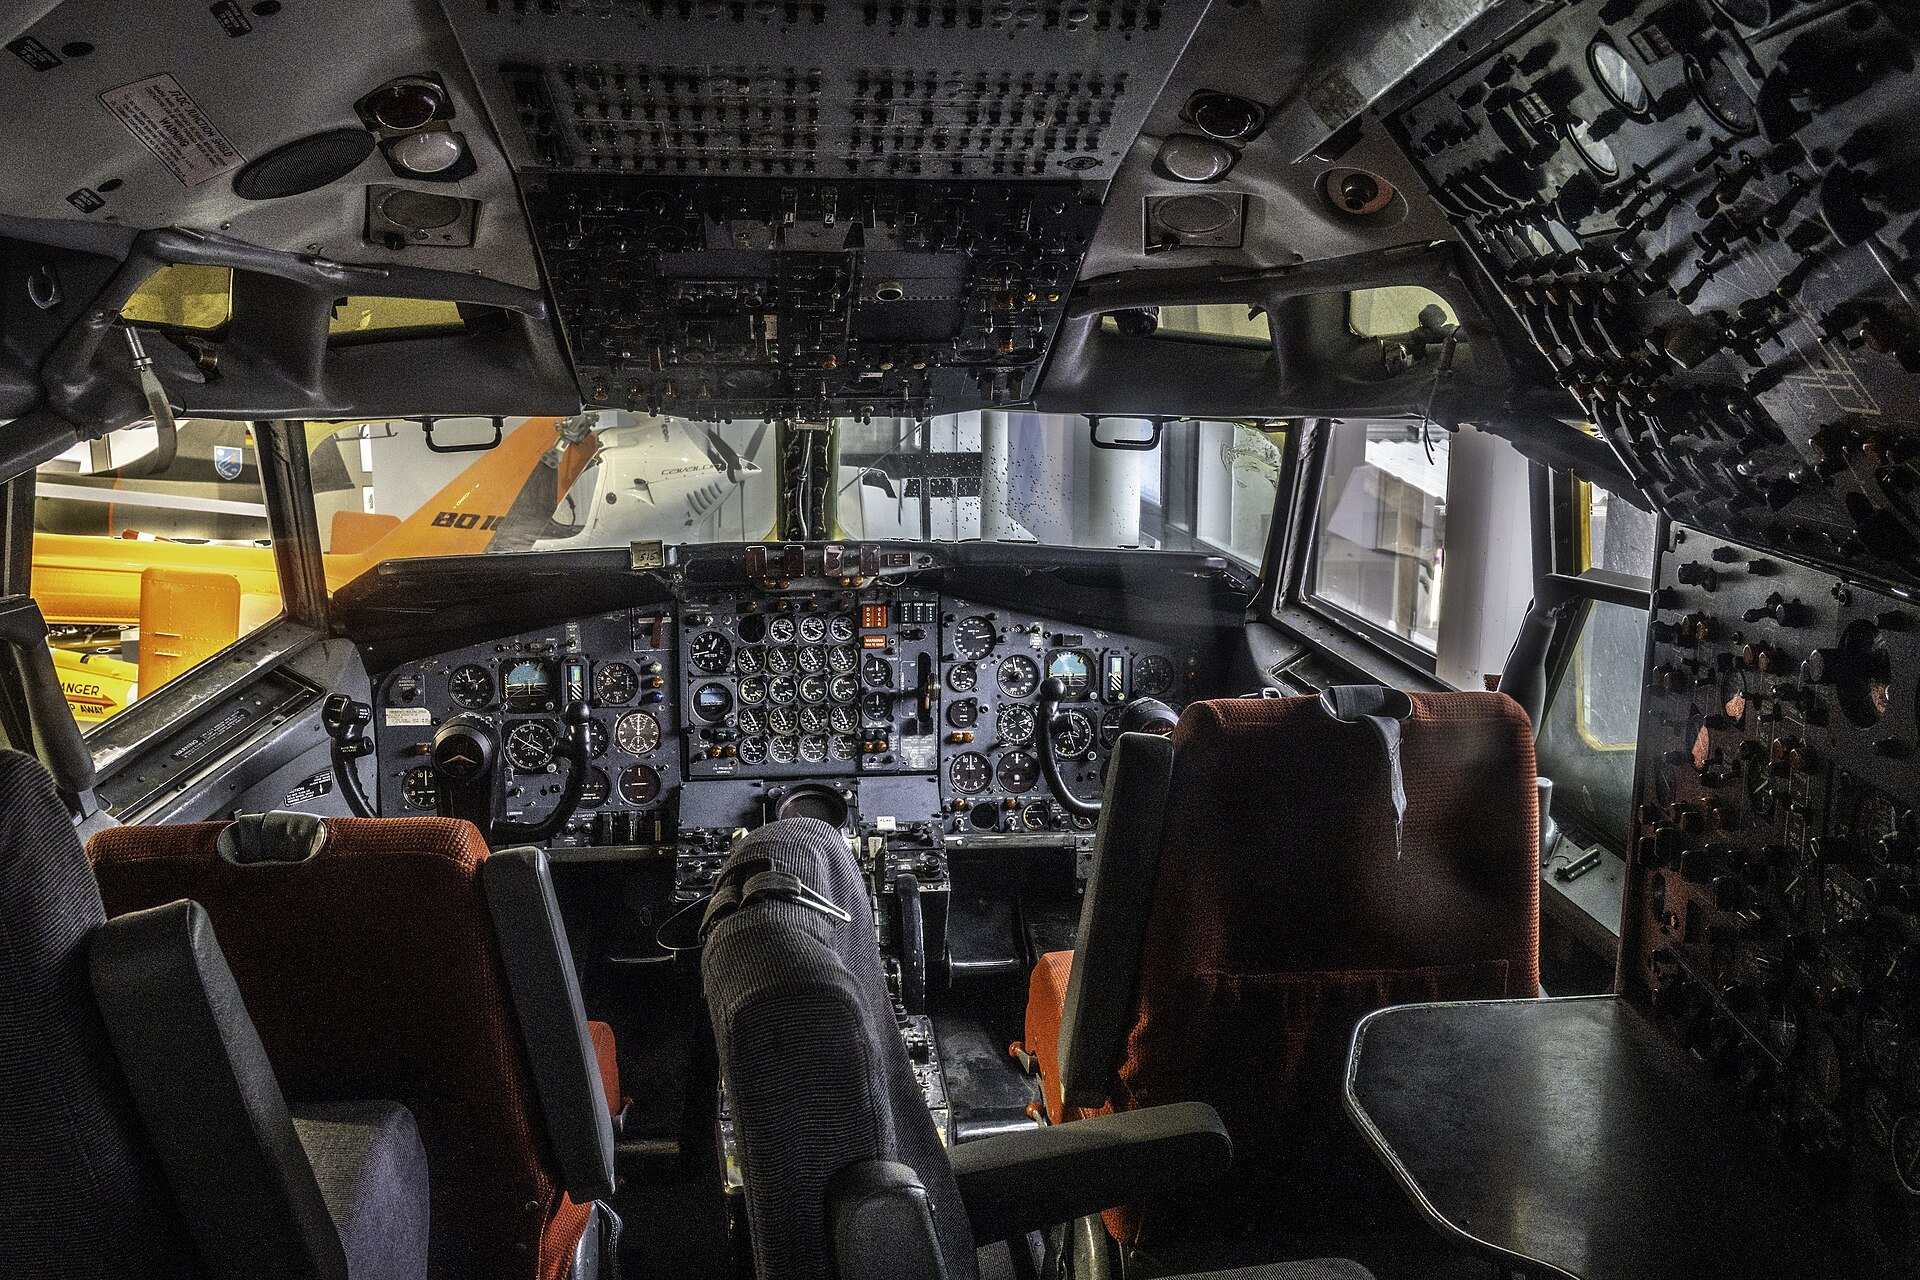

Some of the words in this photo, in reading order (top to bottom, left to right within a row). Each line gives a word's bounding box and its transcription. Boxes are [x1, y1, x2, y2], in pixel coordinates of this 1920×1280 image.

[159, 117, 190, 148] WARNING
[431, 511, 481, 529] BO
[828, 551, 841, 571] 3
[61, 682, 100, 696] ANGER
[80, 704, 104, 715] AWAY
